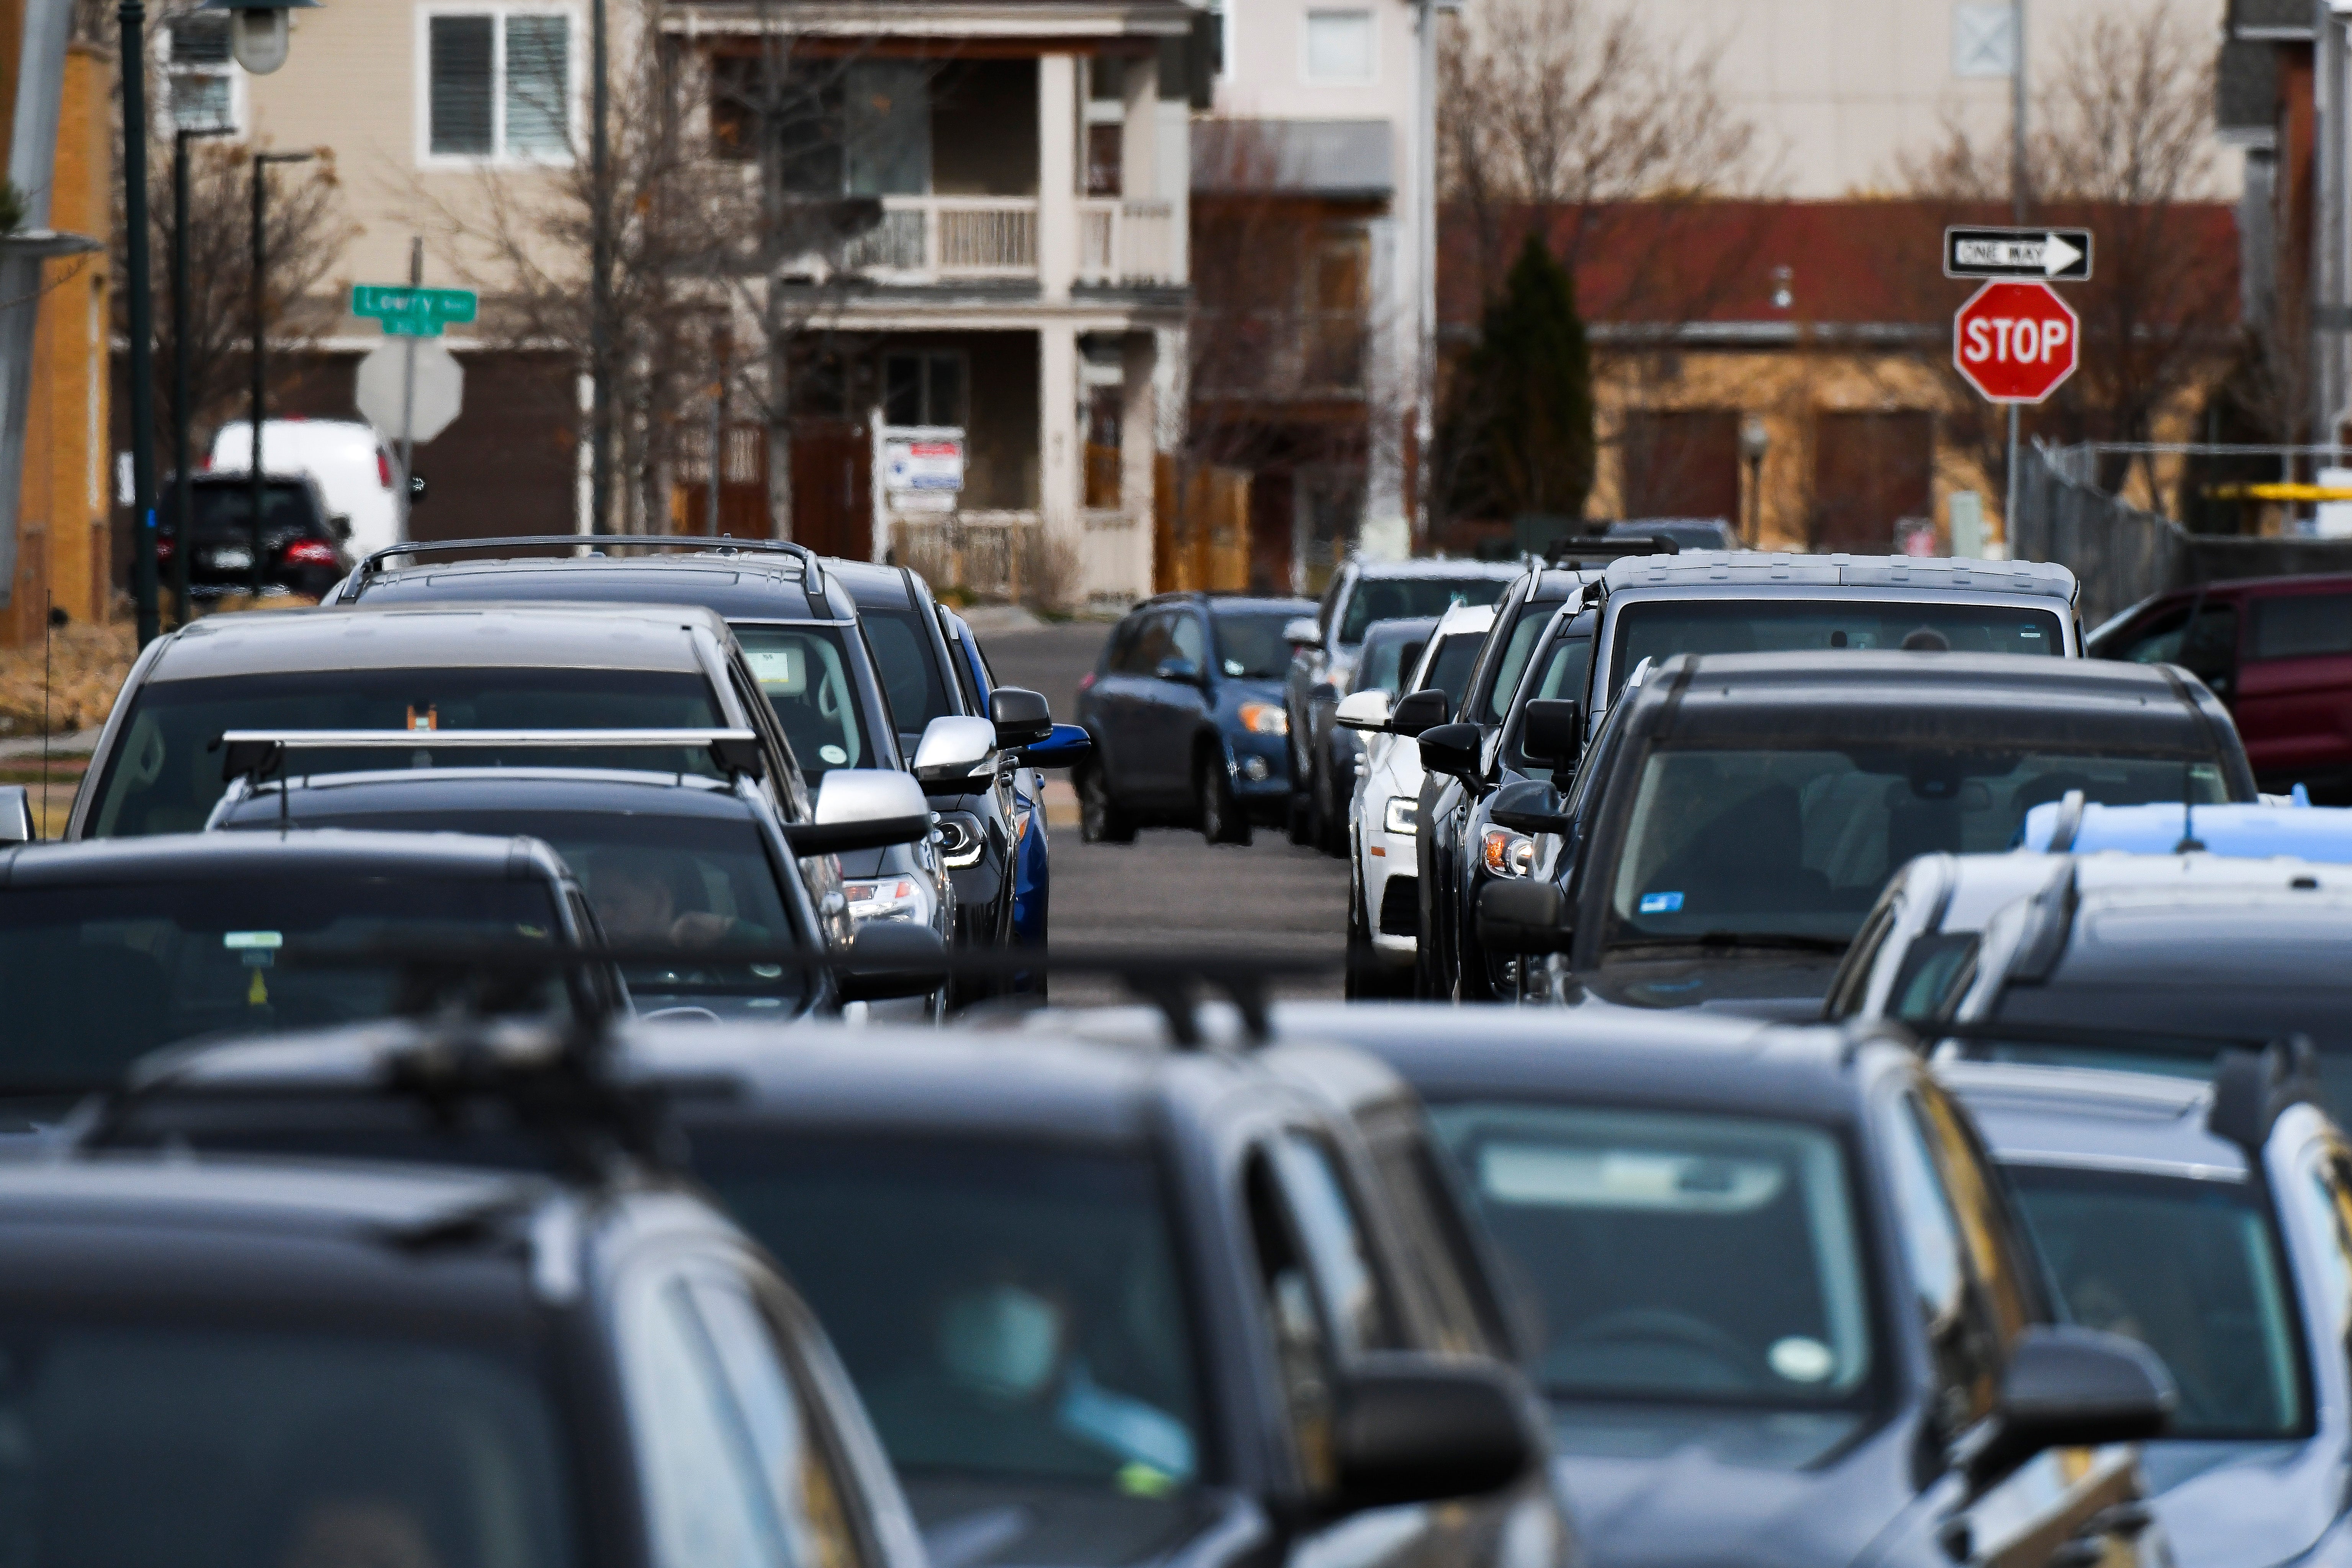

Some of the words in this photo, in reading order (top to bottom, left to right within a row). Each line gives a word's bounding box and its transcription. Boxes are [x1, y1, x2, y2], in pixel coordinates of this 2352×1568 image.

[1960, 241, 1999, 264] ONE
[2007, 242, 2045, 266] WAY
[1964, 317, 2067, 364] STOP
